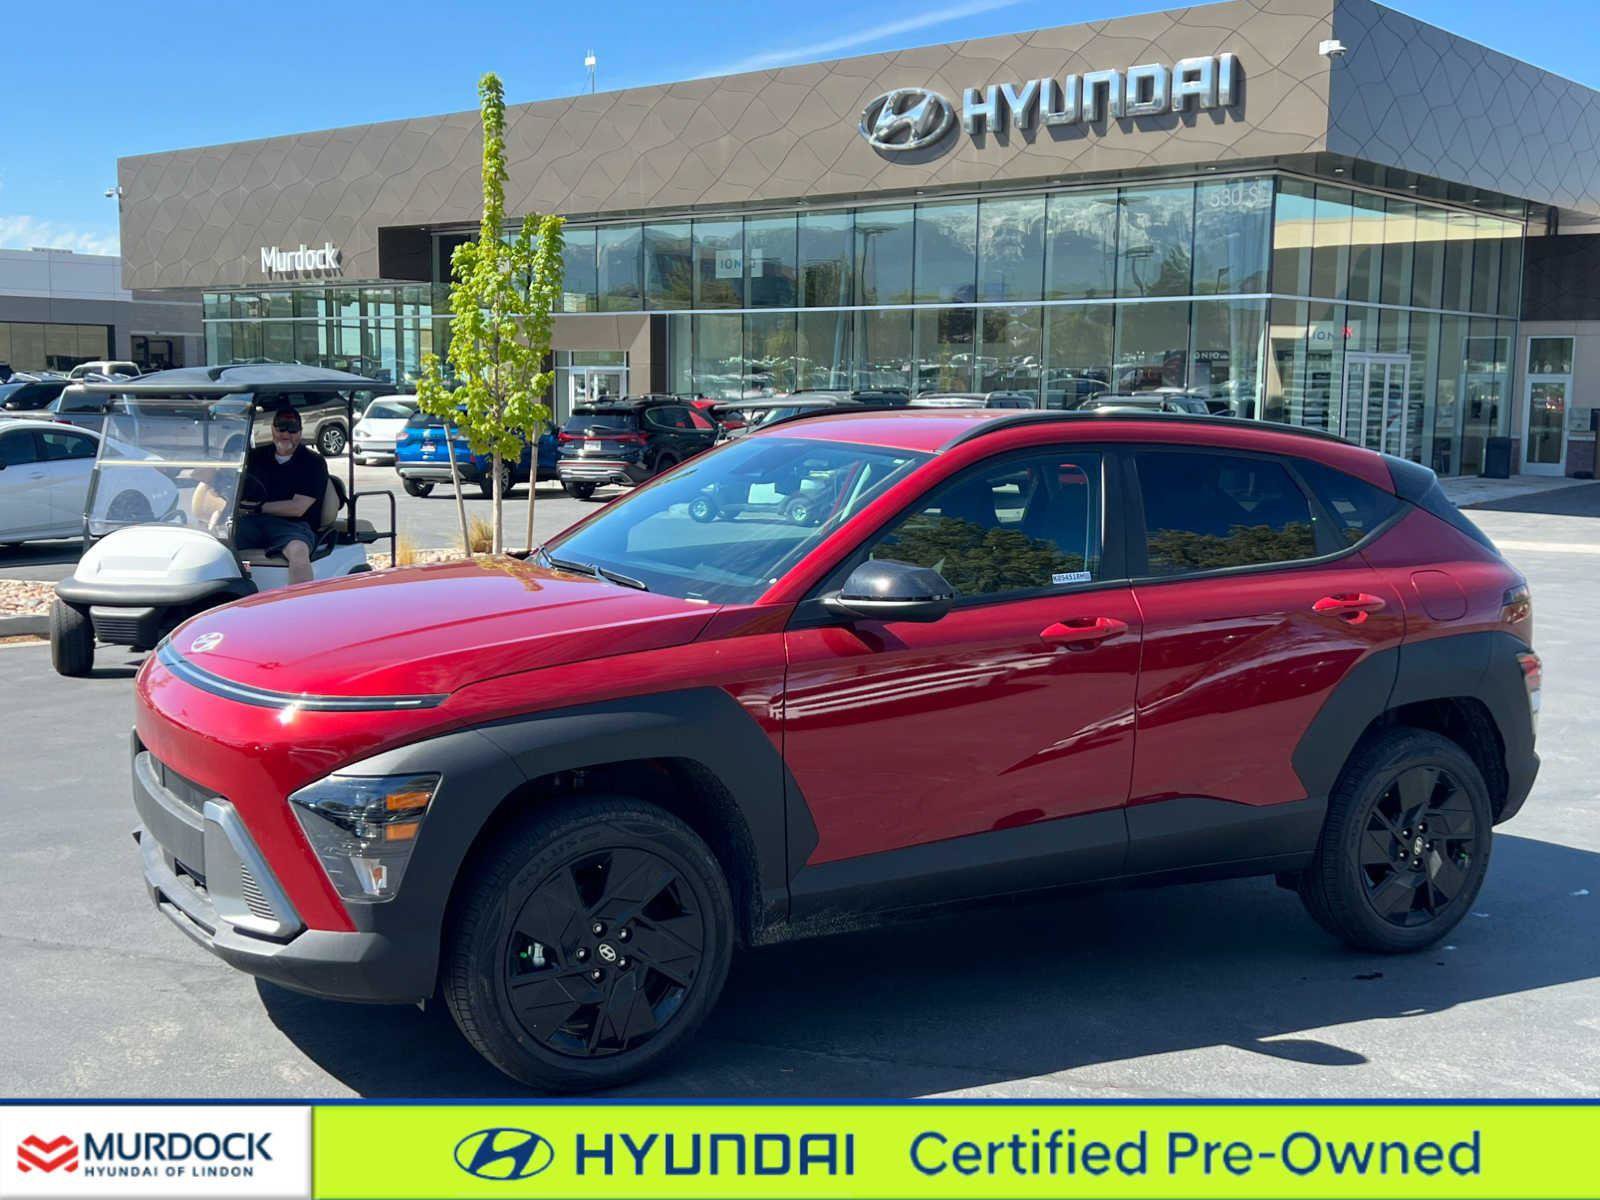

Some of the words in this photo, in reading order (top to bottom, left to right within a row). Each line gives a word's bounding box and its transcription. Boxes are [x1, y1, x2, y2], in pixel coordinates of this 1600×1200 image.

[962, 52, 1238, 136] HYUNDAI
[1209, 187, 1242, 208] 530
[260, 241, 338, 273] Murdock
